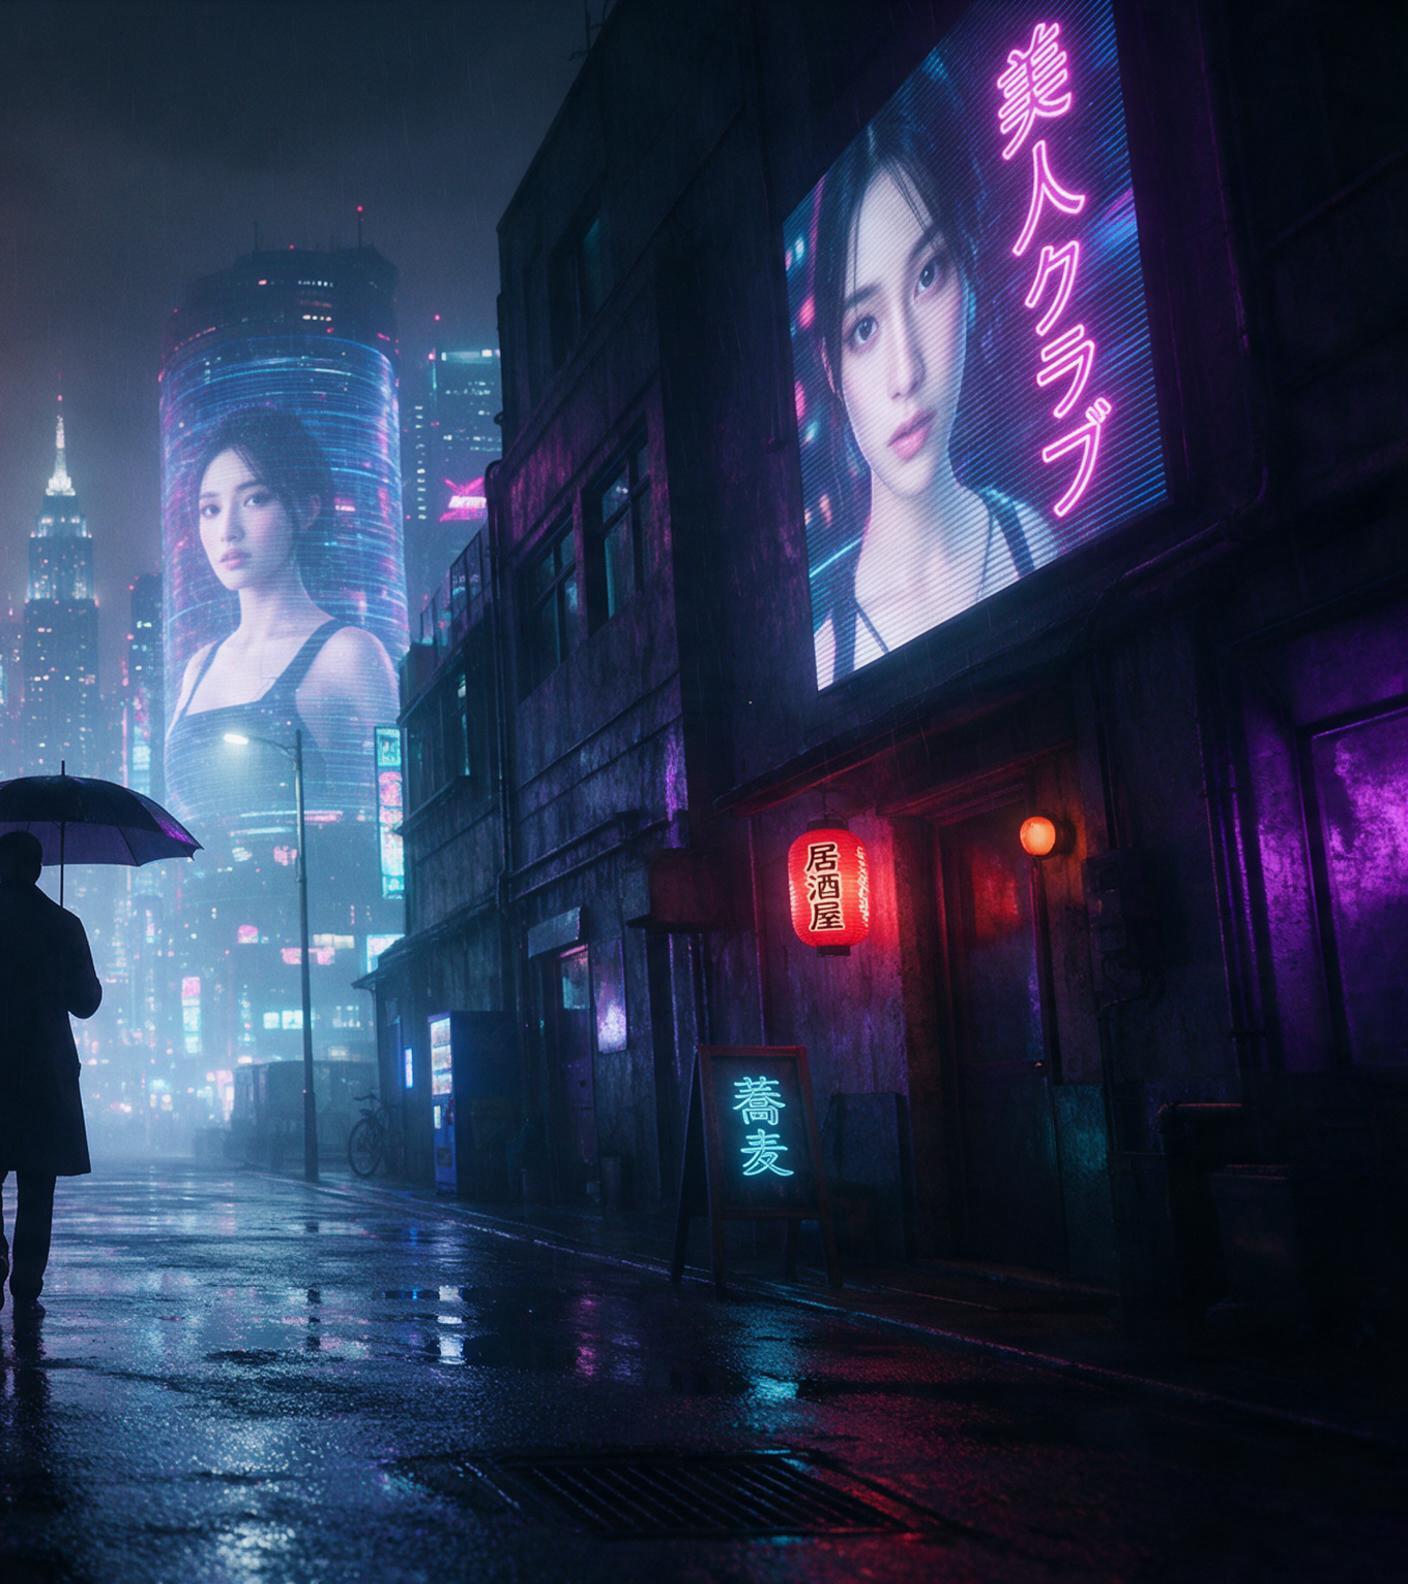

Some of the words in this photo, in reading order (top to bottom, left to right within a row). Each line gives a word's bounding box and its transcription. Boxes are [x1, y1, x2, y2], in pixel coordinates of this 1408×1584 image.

[997, 22, 1112, 517] 美人クラブ
[804, 841, 845, 932] 居酒屋
[733, 1076, 794, 1177] 蕎麦
